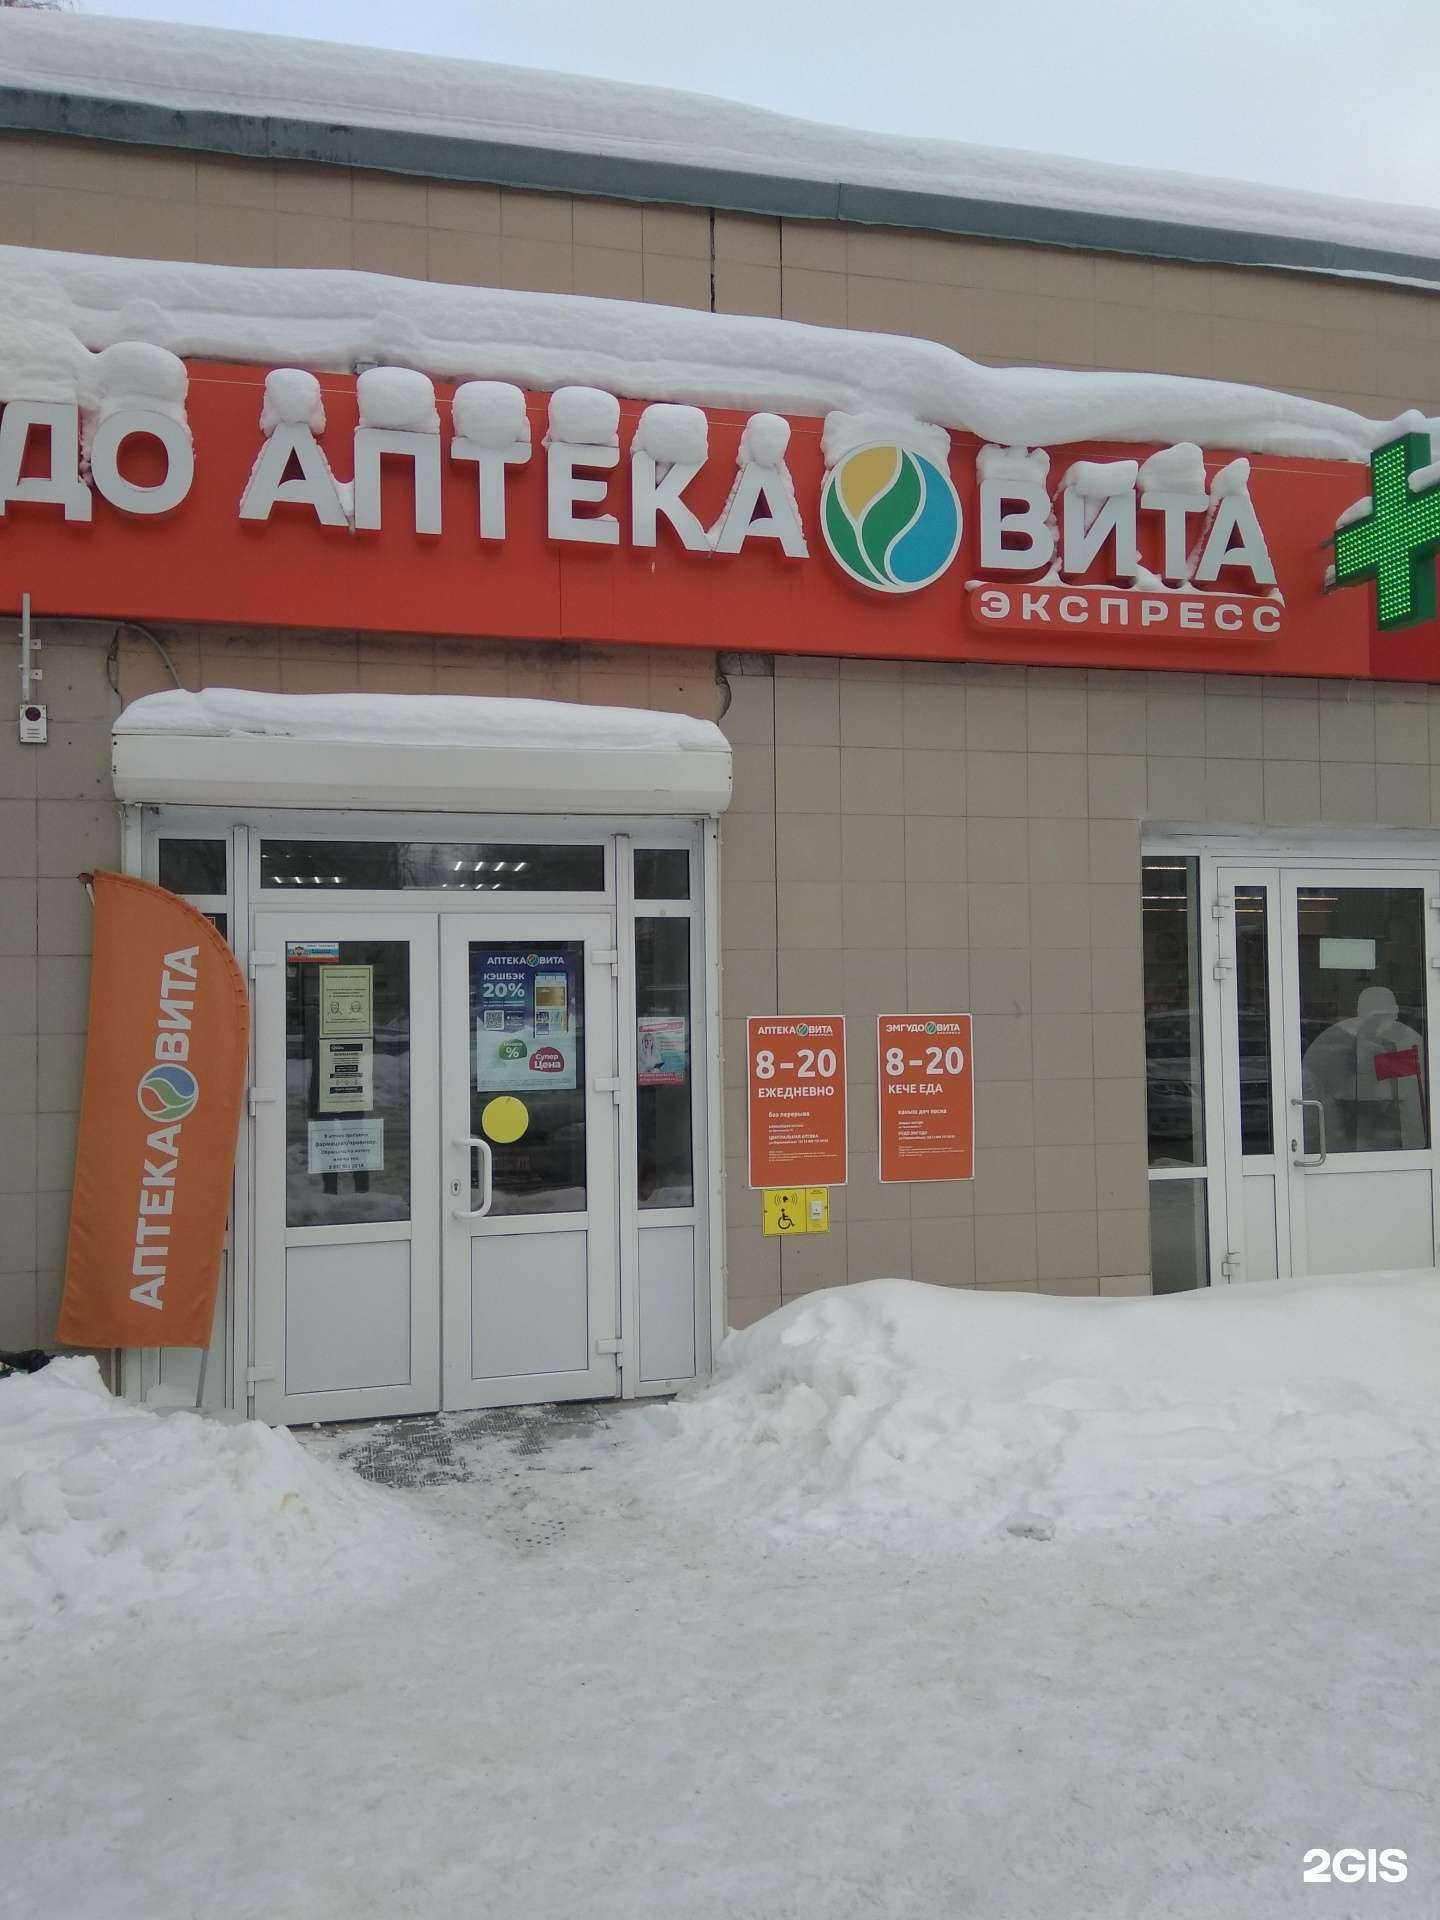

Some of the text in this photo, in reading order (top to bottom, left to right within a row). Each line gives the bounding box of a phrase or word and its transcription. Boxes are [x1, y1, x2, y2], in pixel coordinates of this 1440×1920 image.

[0, 399, 1276, 585] ДО АПТЕКА ВИТА
[979, 590, 1282, 633] ЭКСПРЕСС
[487, 956, 565, 965] АПТЕКА ВИТА
[483, 972, 526, 981] КЭШБЭК
[482, 982, 526, 998] 20%
[758, 1025, 833, 1035] АПТЕКА ВИТА
[886, 1023, 960, 1033] ЭМГУДО ВИТА
[535, 1053, 559, 1062] Супер
[534, 1061, 561, 1071] Цена
[758, 1085, 835, 1100] ЕЖЕДНЕВНО
[888, 1083, 944, 1096] КЕЧЕ ЕДА
[130, 945, 200, 1311] АПТЕКА ВИТА
